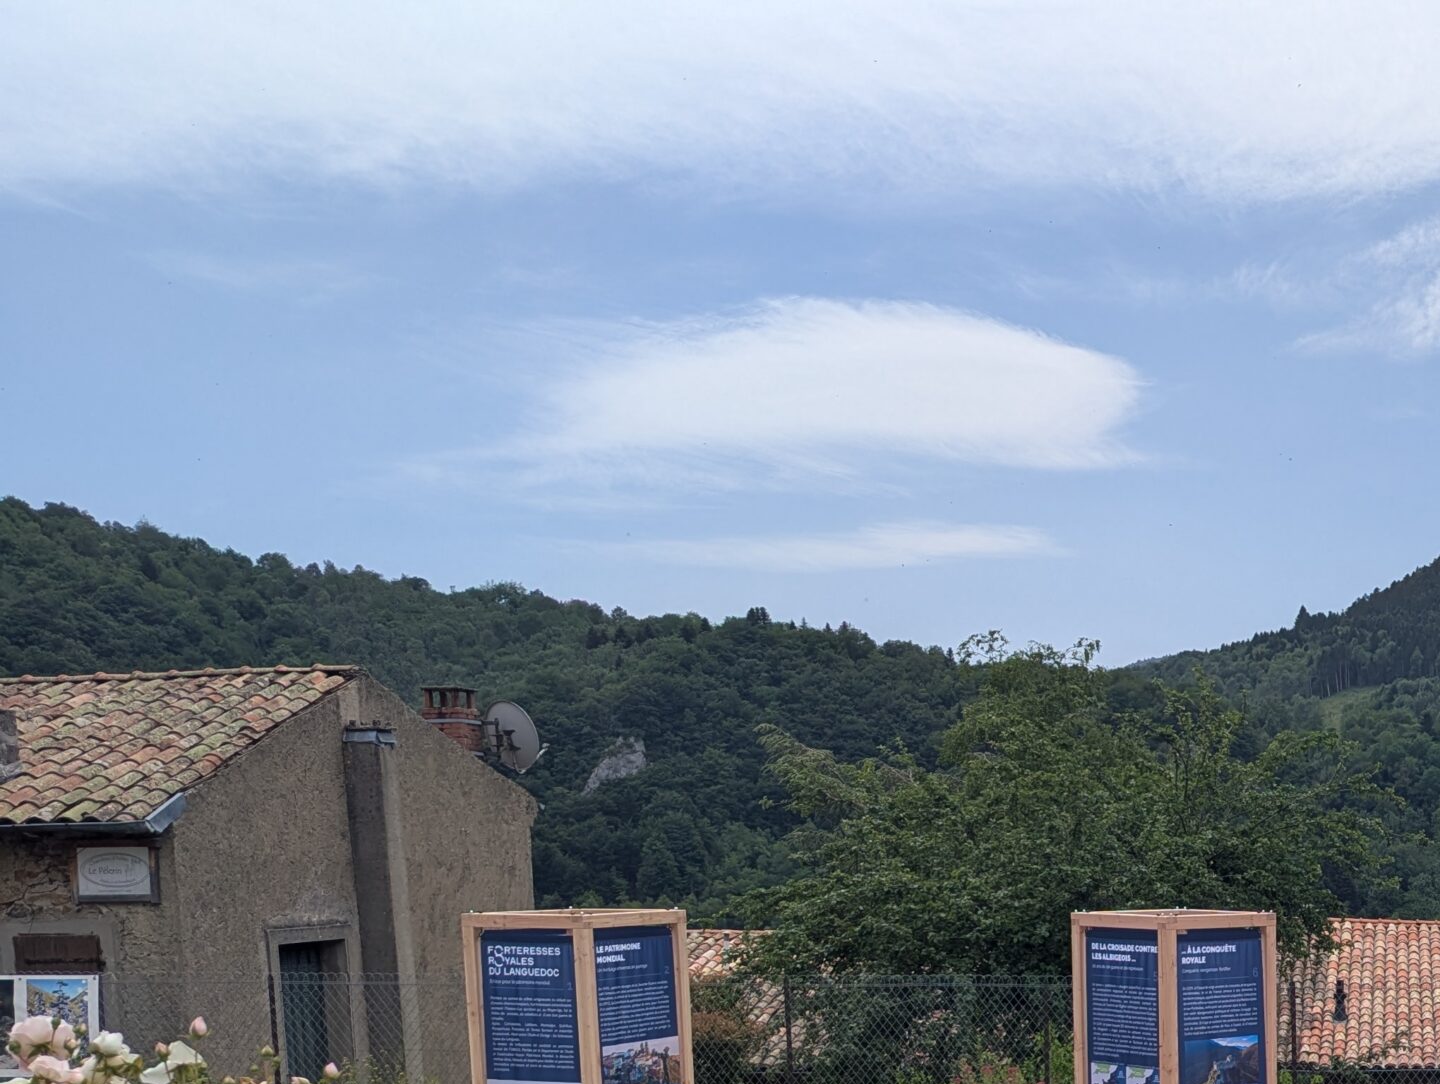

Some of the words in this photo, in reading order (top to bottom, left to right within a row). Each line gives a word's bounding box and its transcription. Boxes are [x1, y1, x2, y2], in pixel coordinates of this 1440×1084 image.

[487, 945, 561, 956] FORTERESSES
[596, 946, 604, 954] LE
[604, 943, 641, 953] PATRIMOINE
[1100, 943, 1107, 951] LA
[1107, 944, 1134, 952] CROISADE
[1135, 945, 1159, 953] CONTRE
[1192, 946, 1201, 954] LA
[1201, 943, 1237, 954] CONQUÊTE
[488, 955, 535, 967] ROYALES
[597, 954, 626, 964] MONDIAL
[1092, 952, 1101, 960] LES
[1181, 956, 1206, 964] ROYALE
[489, 967, 501, 976] DU
[503, 967, 560, 977] LANGUEDOC
